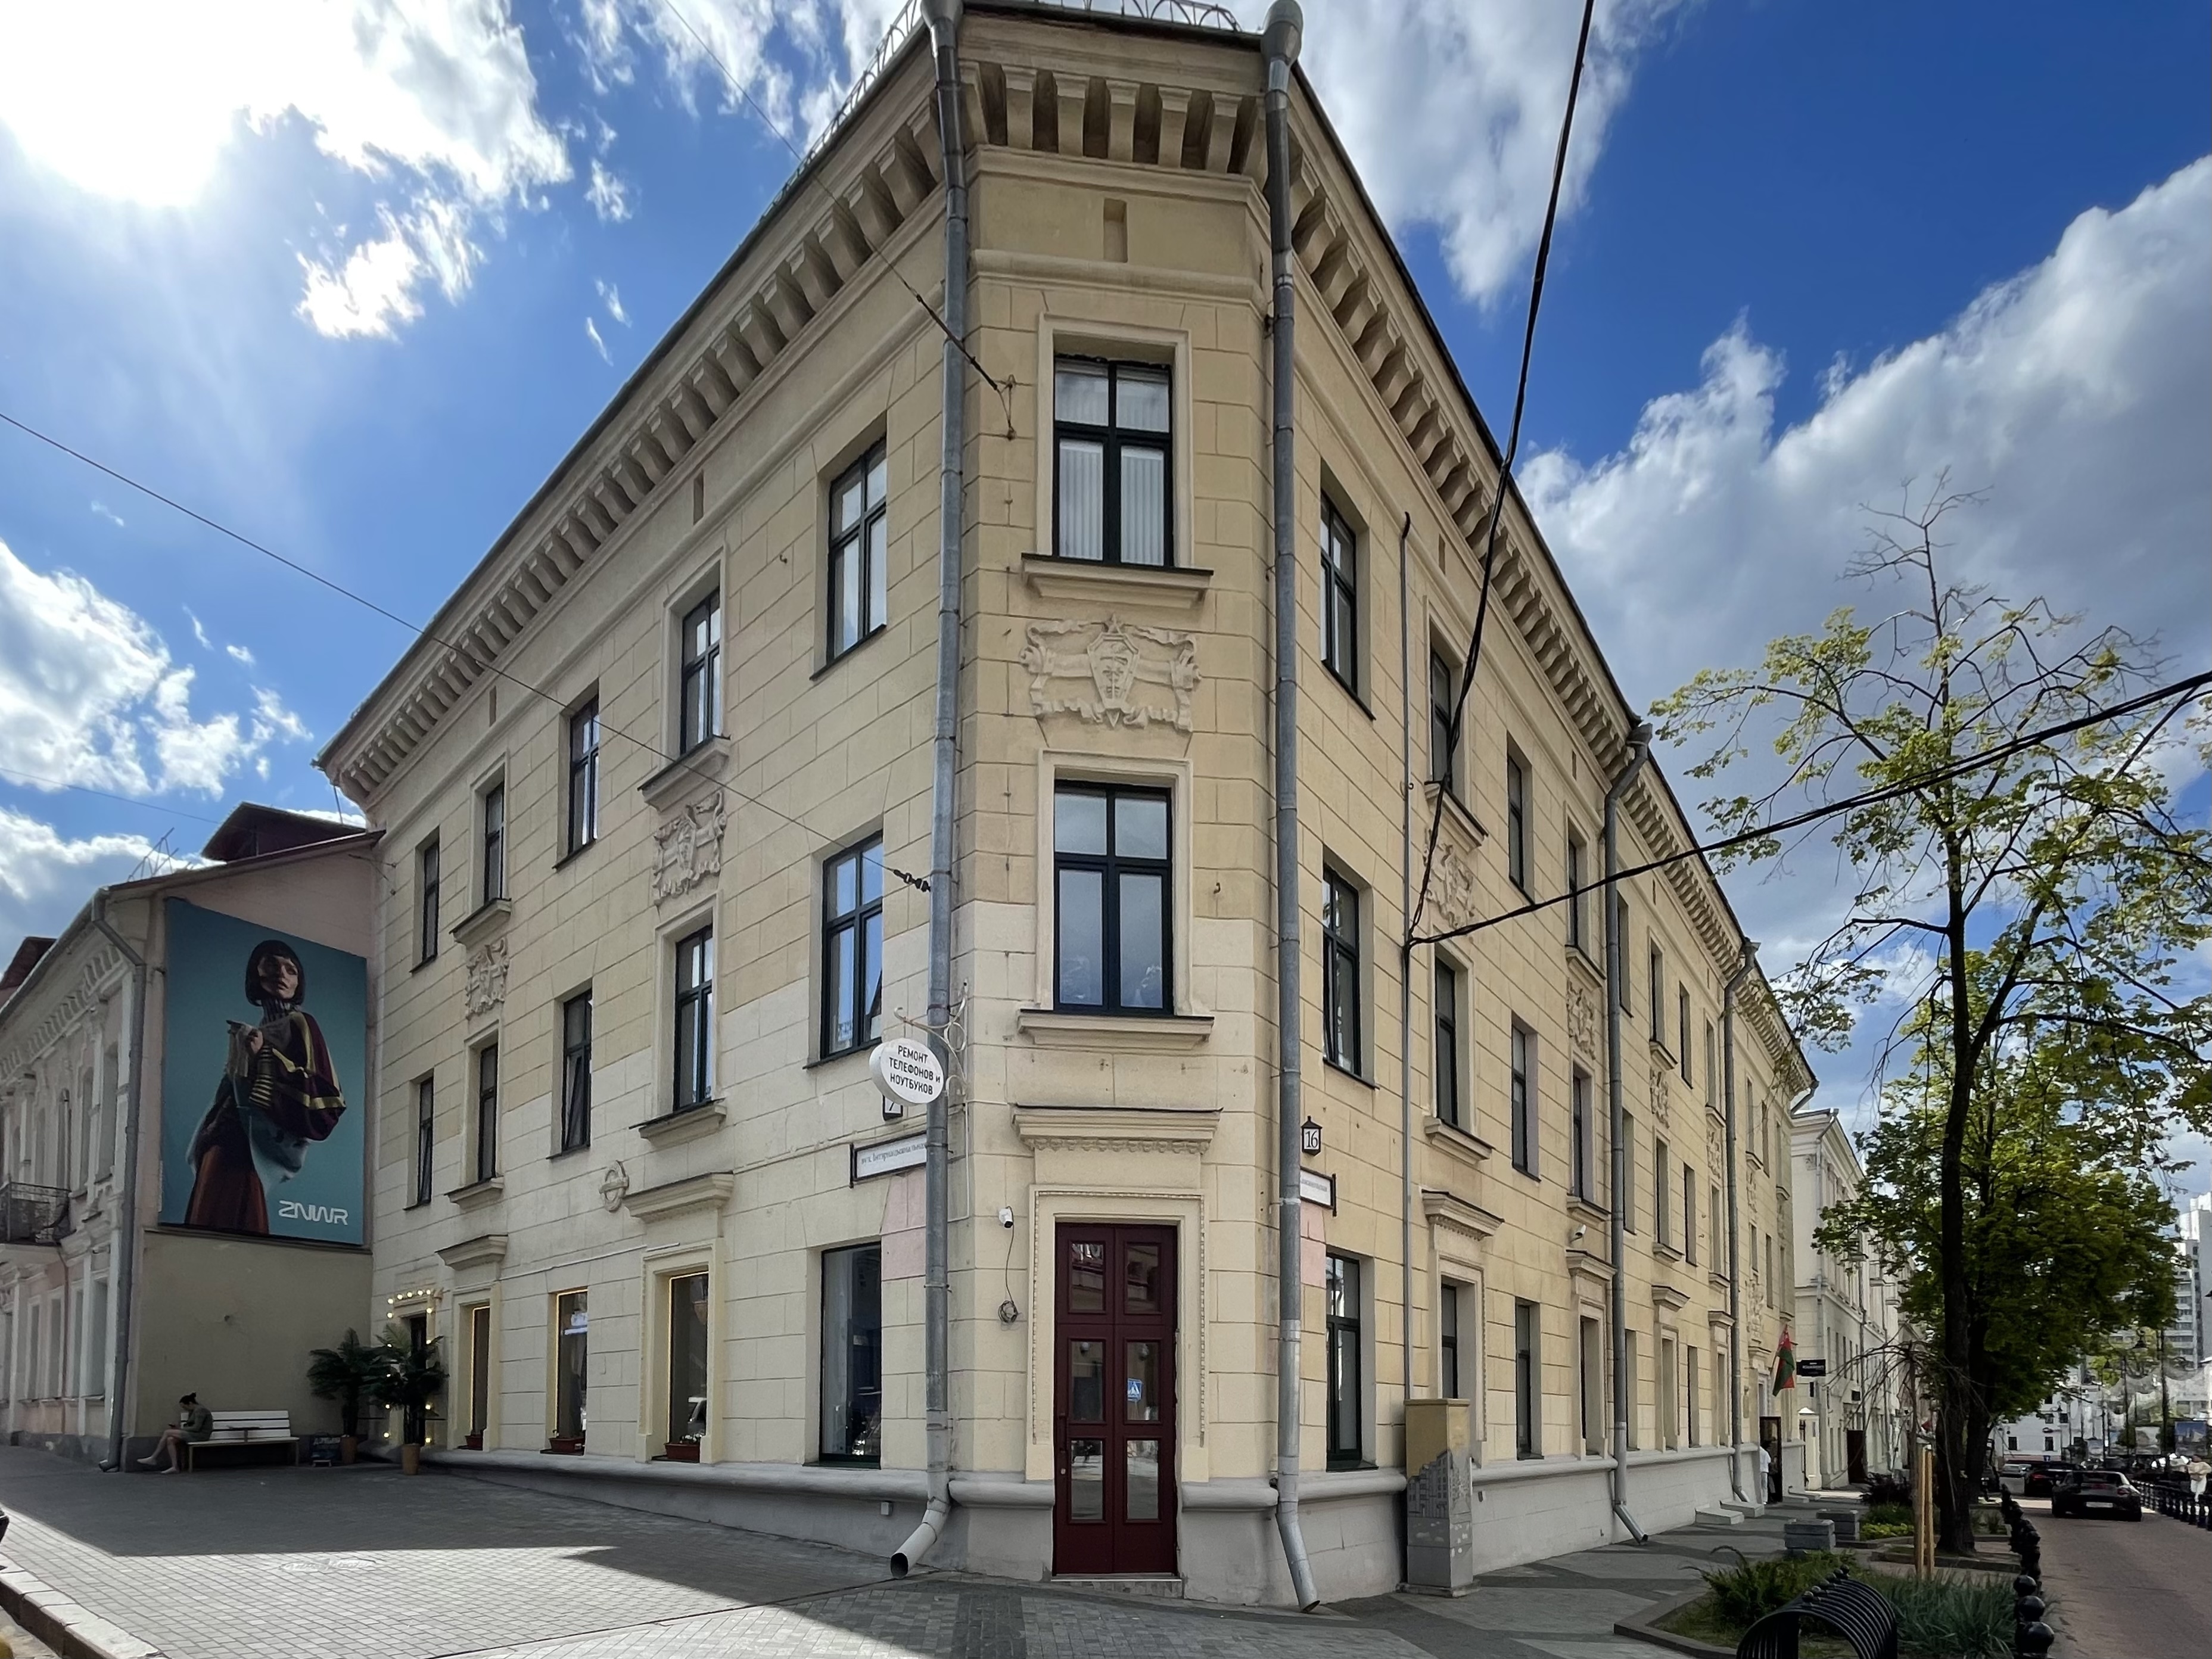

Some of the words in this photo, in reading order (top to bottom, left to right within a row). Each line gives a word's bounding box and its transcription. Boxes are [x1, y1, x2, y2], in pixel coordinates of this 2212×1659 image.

[898, 1045, 928, 1064] РЕМОНТ
[889, 1057, 934, 1080] ТЕЛЕФОНОВ
[890, 1073, 933, 1095] НОУТБУКОВ
[1305, 1130, 1318, 1148] 16
